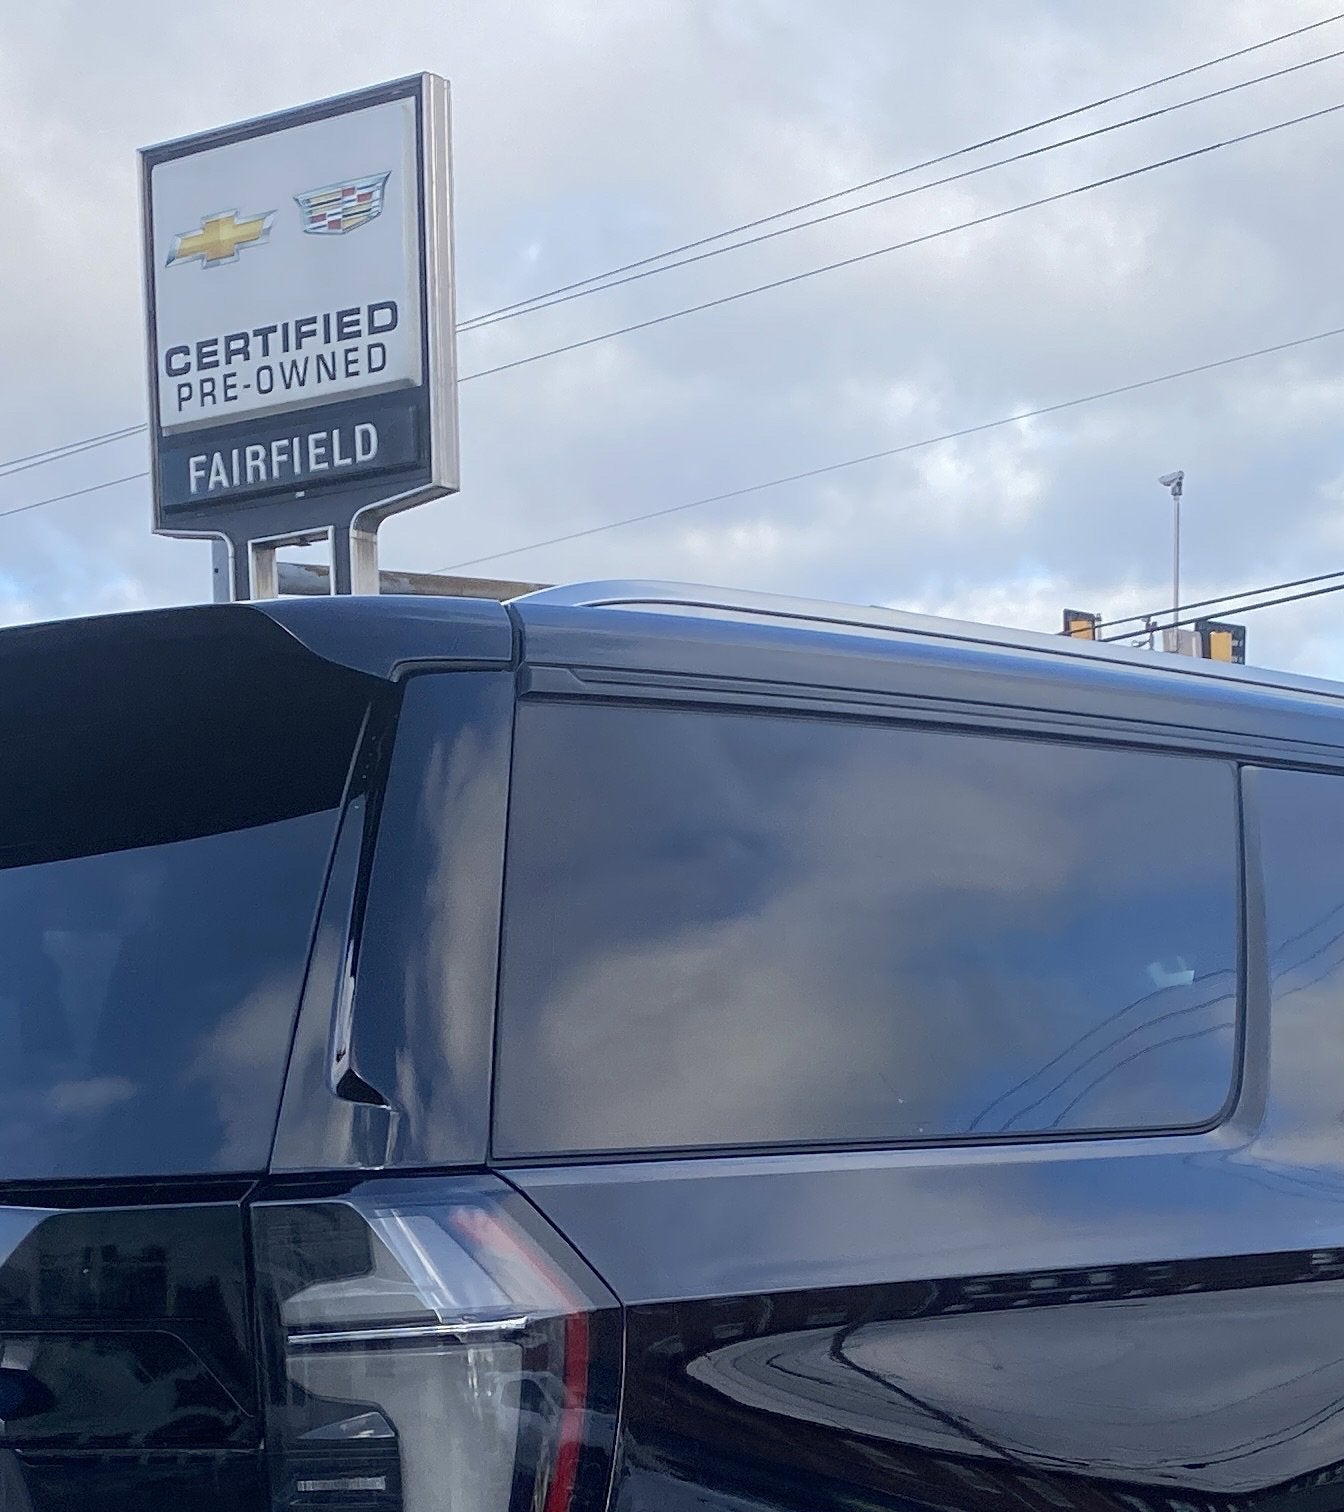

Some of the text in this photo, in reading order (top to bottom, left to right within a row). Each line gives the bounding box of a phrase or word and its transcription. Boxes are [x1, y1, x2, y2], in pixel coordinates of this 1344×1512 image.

[164, 300, 399, 378] CERTIFIED
[176, 341, 388, 412] PRE-OWNED
[189, 422, 379, 495] FAIRFIELD
